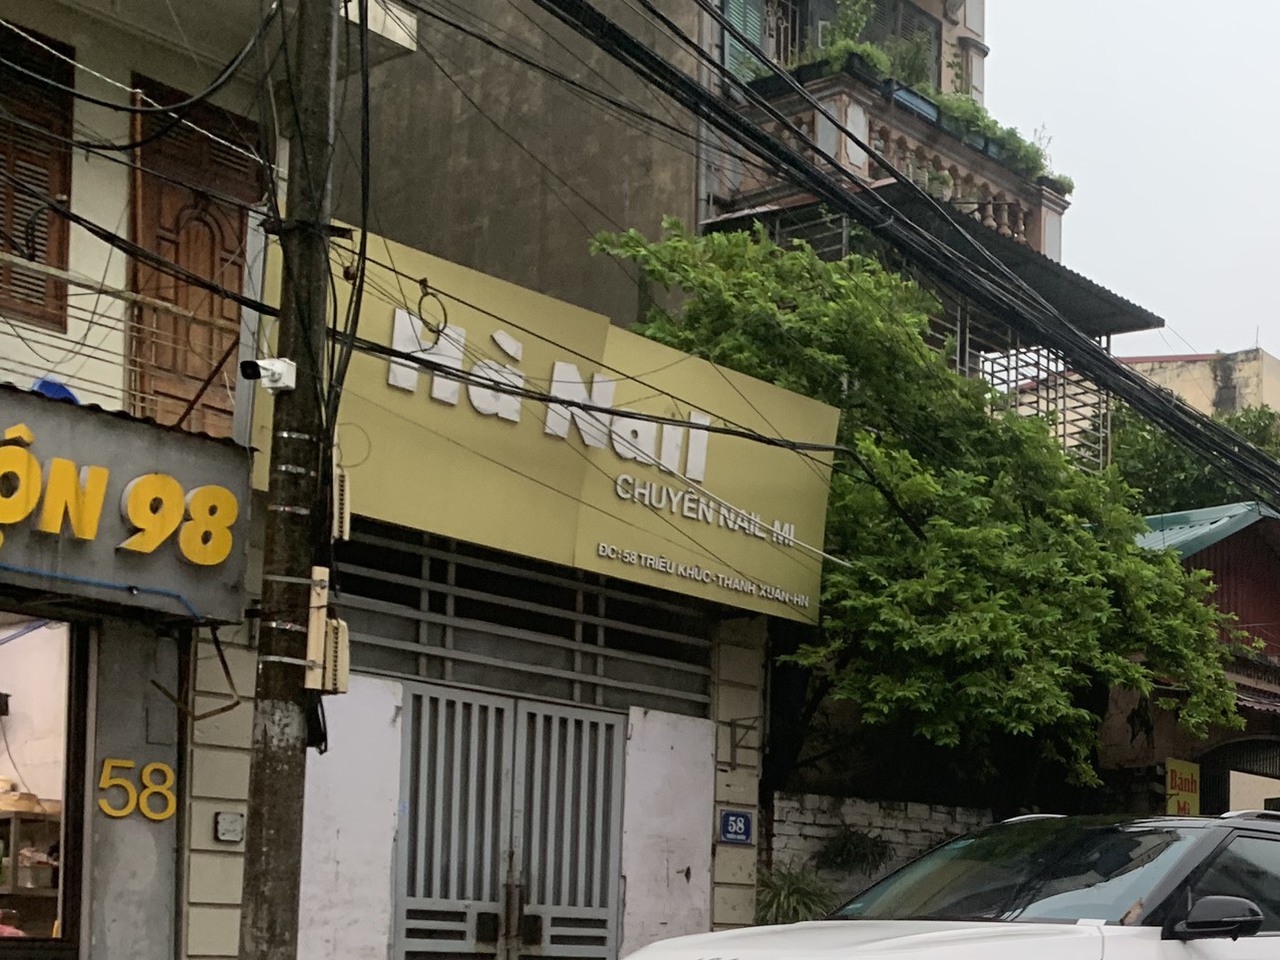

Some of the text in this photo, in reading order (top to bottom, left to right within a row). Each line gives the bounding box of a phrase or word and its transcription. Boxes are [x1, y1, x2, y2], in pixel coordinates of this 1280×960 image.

[388, 307, 710, 482] Hà Nail
[116, 472, 238, 566] 98
[615, 473, 715, 523] CHUYÊN
[98, 757, 178, 821] 58
[1170, 768, 1197, 794] Bánh
[728, 816, 746, 834] 58
